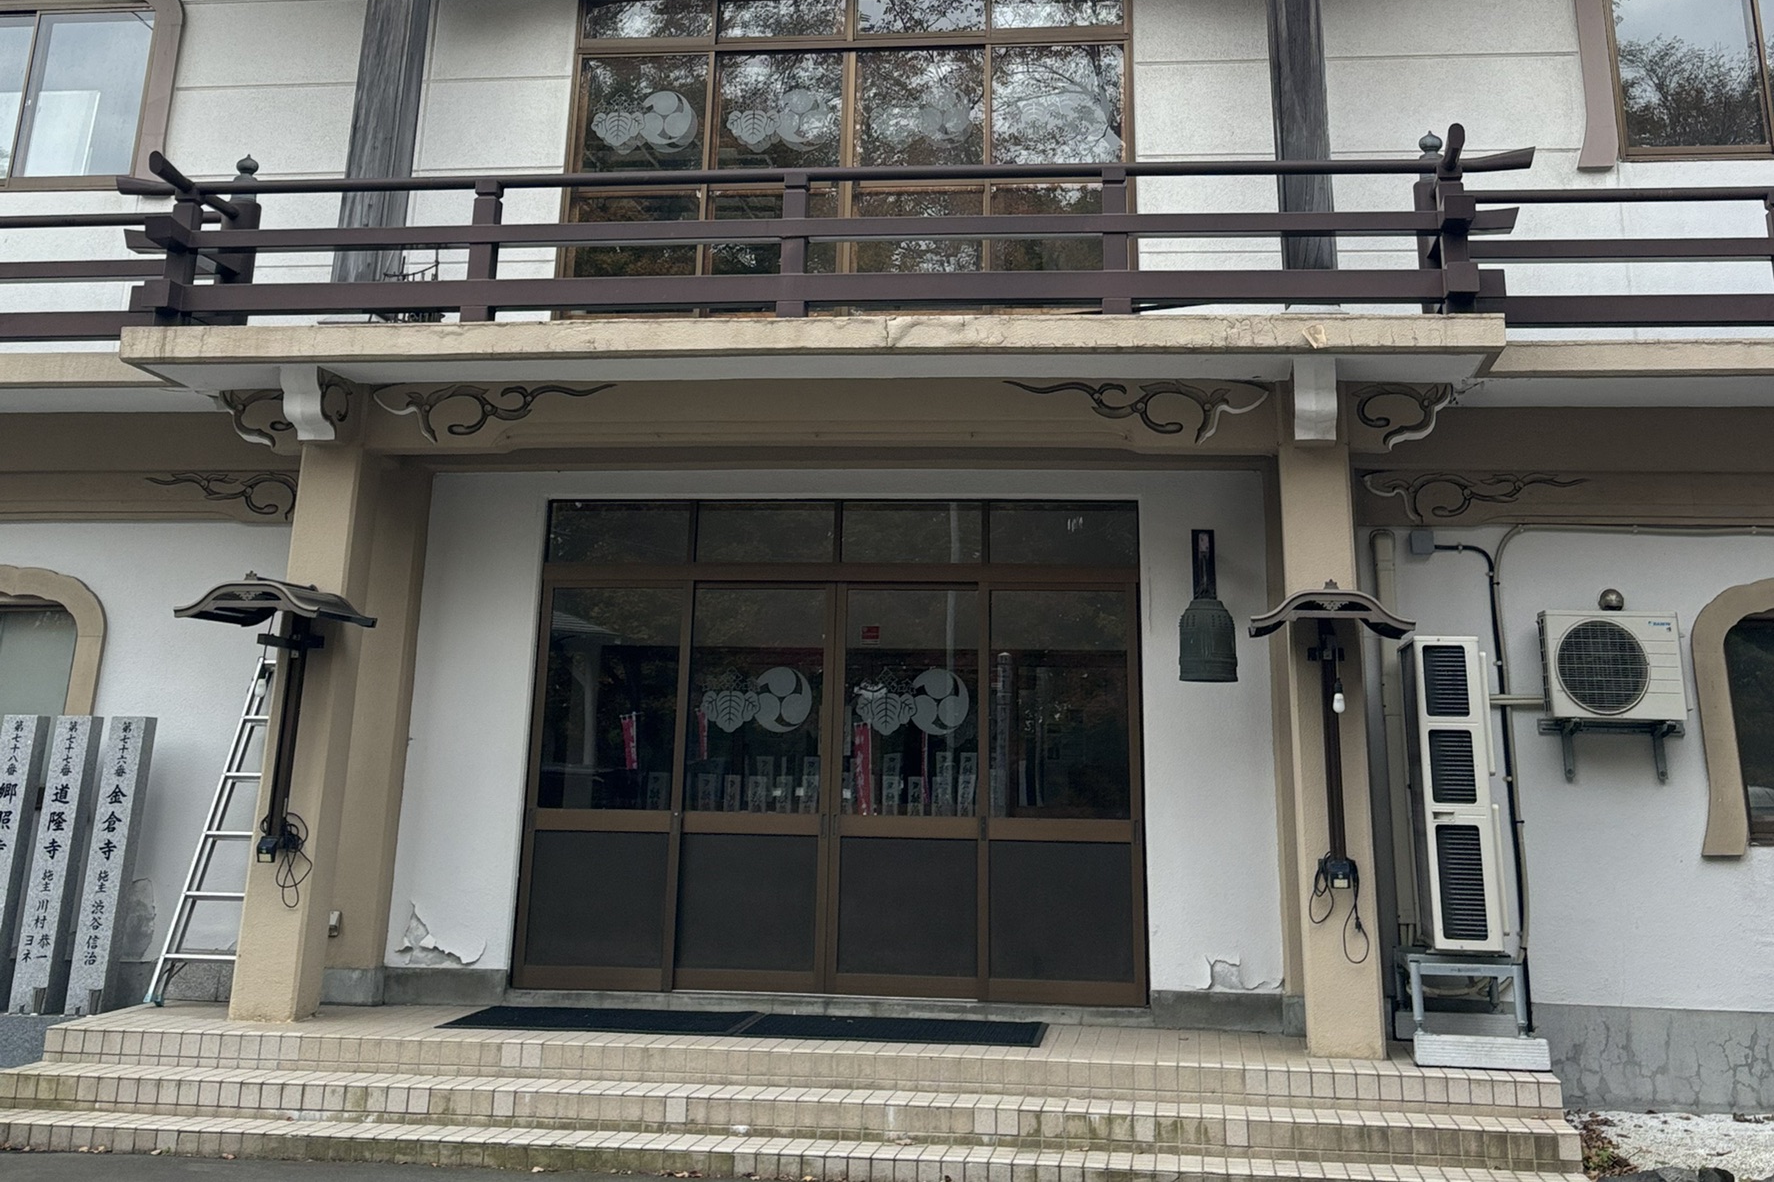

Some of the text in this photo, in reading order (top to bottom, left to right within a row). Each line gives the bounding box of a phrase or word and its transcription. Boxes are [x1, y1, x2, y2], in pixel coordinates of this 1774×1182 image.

[5, 720, 24, 776] 第七十八番
[59, 720, 78, 777] 第七十七番
[114, 721, 133, 778] 第七十六番
[43, 783, 70, 860] 道隆寺
[98, 784, 128, 861] 金倉寺
